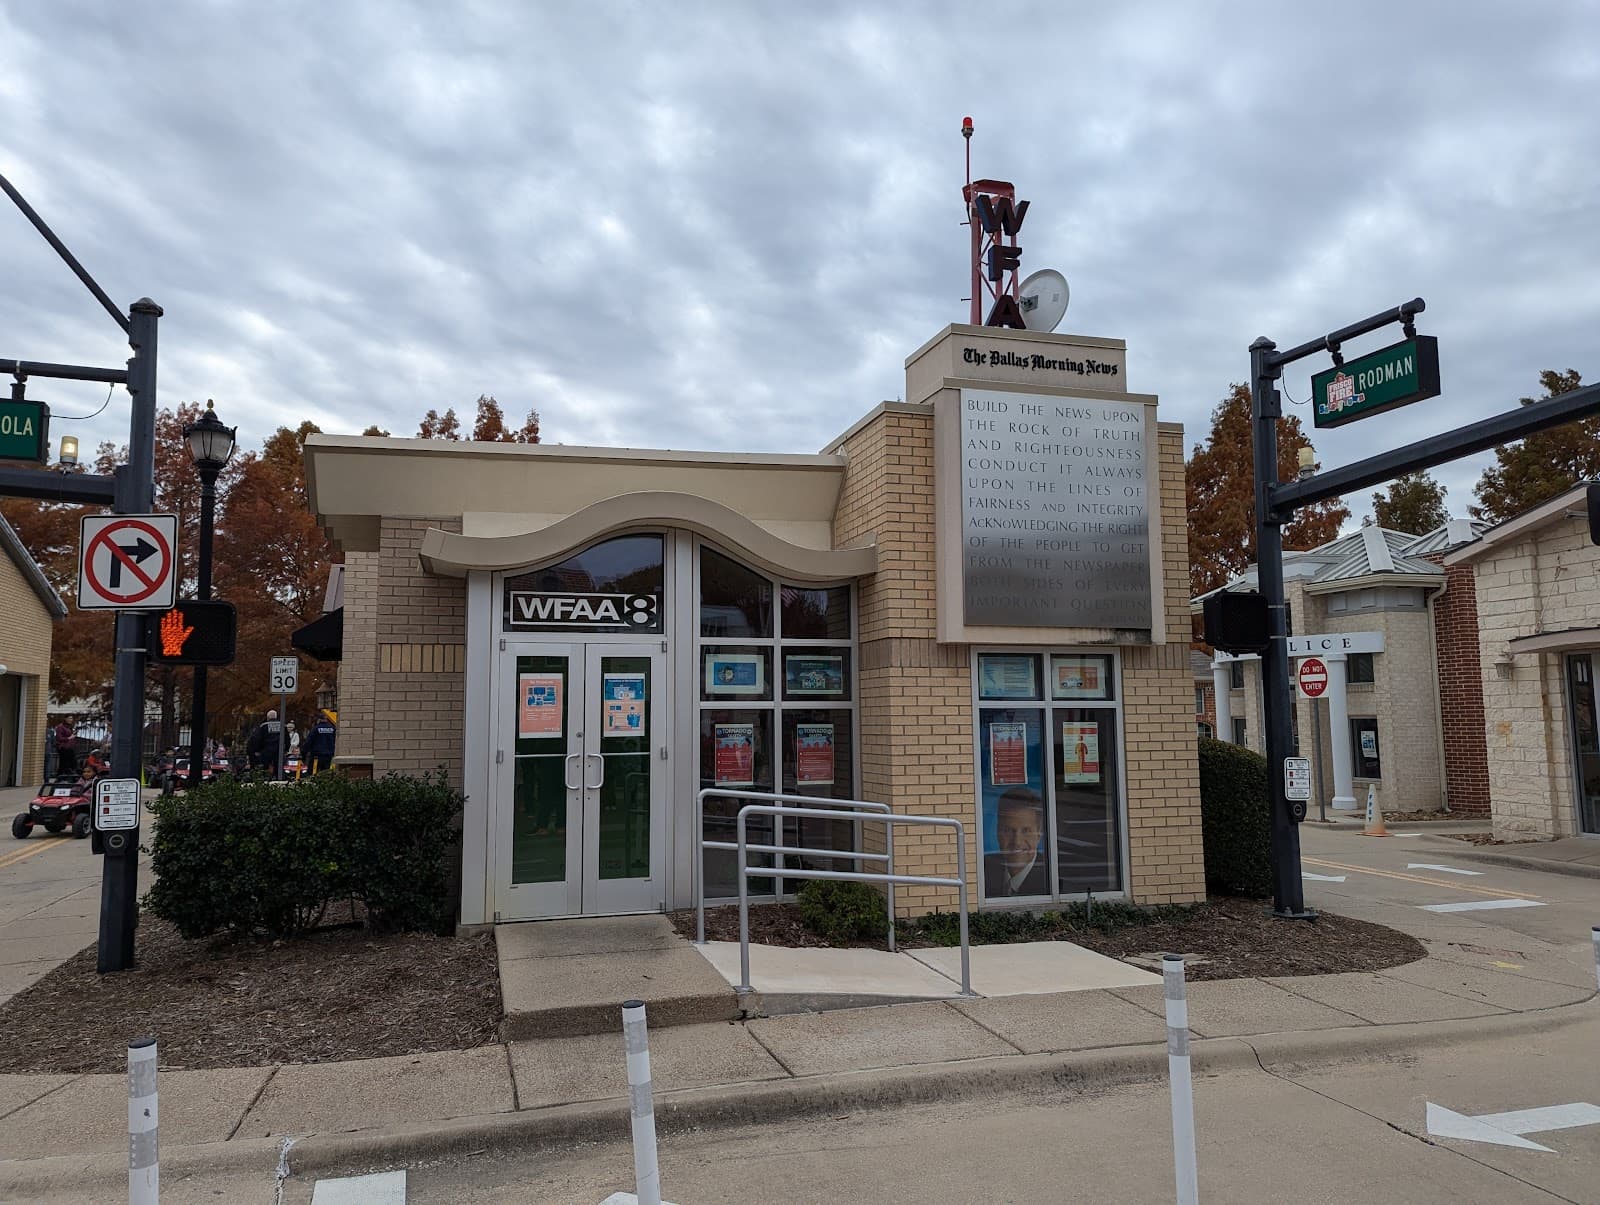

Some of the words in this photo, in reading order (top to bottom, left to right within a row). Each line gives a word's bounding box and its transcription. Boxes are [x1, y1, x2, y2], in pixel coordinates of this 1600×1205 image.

[963, 347, 987, 366] The
[989, 350, 1030, 370] Dallas
[1031, 353, 1085, 376] Morning
[1085, 359, 1118, 377] News
[1359, 355, 1413, 391] RODMAN
[1328, 378, 1353, 394] FRISCO
[1329, 384, 1354, 403] FIRE
[967, 399, 1008, 413] BUILD
[1019, 403, 1045, 416] THE
[1055, 406, 1092, 420] NEWS
[1102, 410, 1140, 423] UPON
[1, 415, 33, 436] OLA
[967, 418, 997, 432] THE
[1009, 421, 1050, 436] ROCK
[1062, 426, 1081, 438] OF
[1094, 428, 1141, 442] TRUTH
[967, 439, 1001, 451] AND
[1014, 441, 1142, 461] RIGHTEOUSNESS
[968, 457, 1048, 473] CONDUCT
[1060, 463, 1073, 476] IT
[1085, 465, 1142, 480] ALWAYS
[968, 477, 1015, 490] UPON
[1026, 480, 1057, 493] THE
[1069, 483, 1111, 497] LINES
[1123, 486, 1143, 498] OF
[969, 496, 1031, 511] FAIRNESS
[1041, 503, 1066, 513] AND
[1077, 503, 1143, 517] INTEGRITY
[1080, 521, 1105, 534] THE
[1107, 523, 1145, 536] RIGHT
[969, 536, 989, 548] OF
[1000, 537, 1025, 550] THE
[1035, 539, 1082, 552] PEOPLE
[1092, 541, 1111, 553] TO
[1120, 542, 1145, 555] GET
[969, 555, 1013, 569] FROM
[1025, 557, 1052, 570] THE
[1063, 559, 1146, 575] NEWSPAPER
[1024, 576, 1063, 591] SIDES
[1075, 579, 1095, 592] OF
[517, 596, 621, 621] WFAA
[624, 594, 656, 627] 8
[970, 595, 1057, 610] IMPORTANT
[1313, 665, 1323, 673] NOT
[273, 675, 295, 688] 30
[1305, 683, 1322, 691] ENTER
